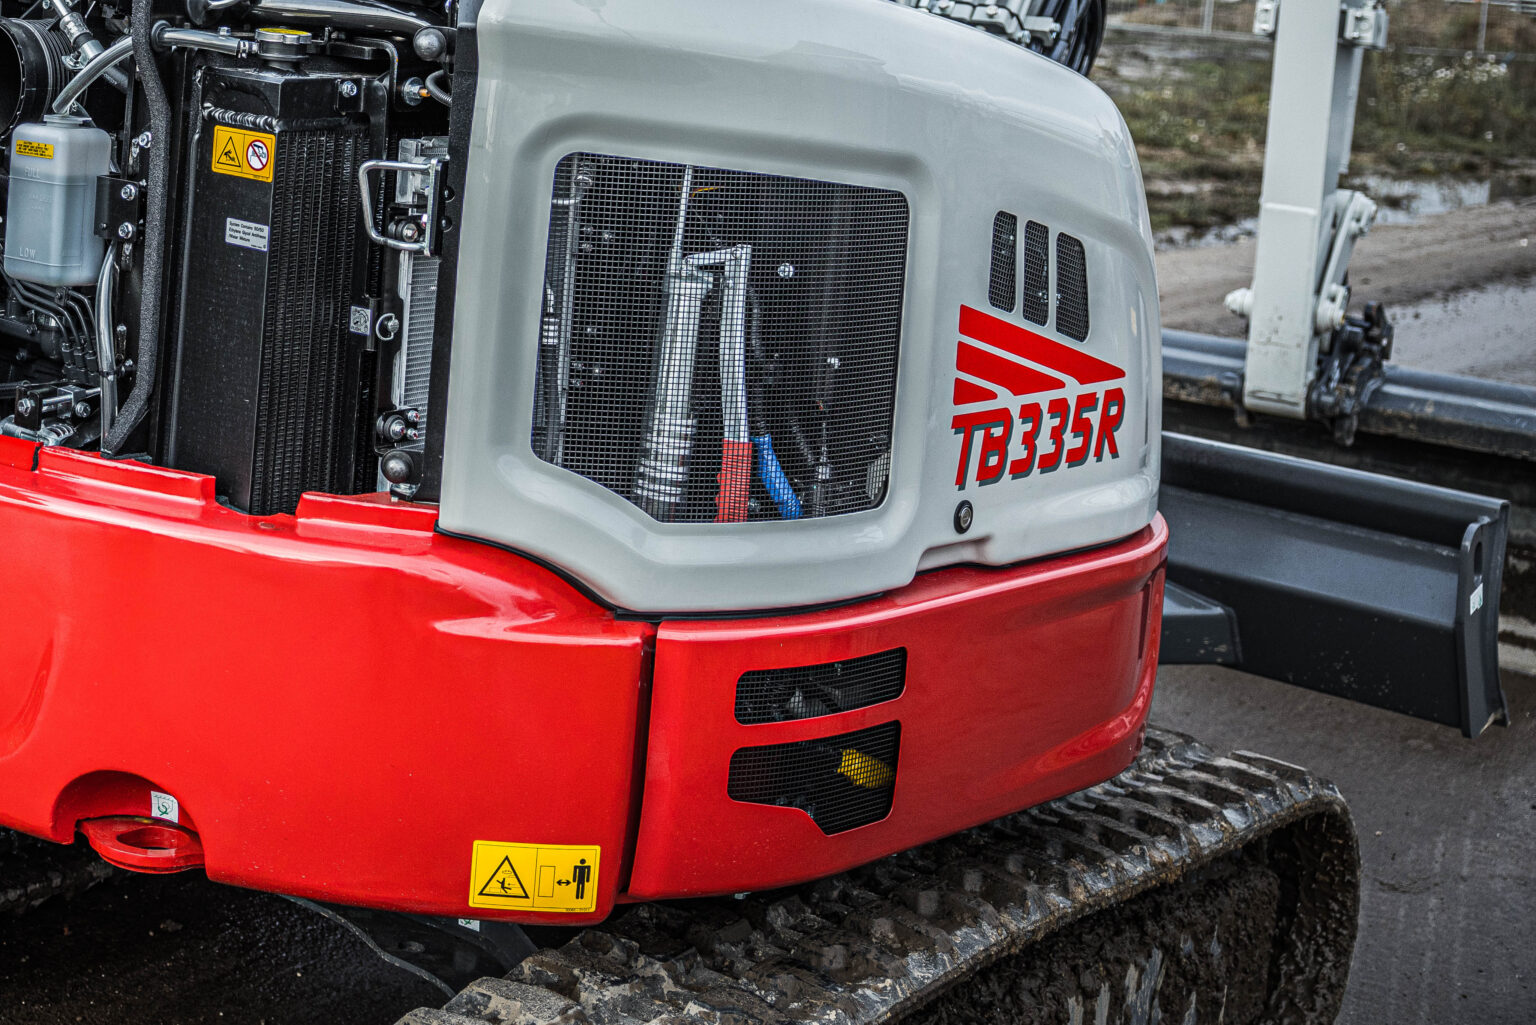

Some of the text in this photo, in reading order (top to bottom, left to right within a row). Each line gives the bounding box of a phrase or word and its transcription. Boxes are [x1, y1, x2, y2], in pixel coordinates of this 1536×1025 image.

[24, 167, 40, 178] FULL
[19, 247, 36, 259] LOW
[951, 387, 1126, 492] TB335R
